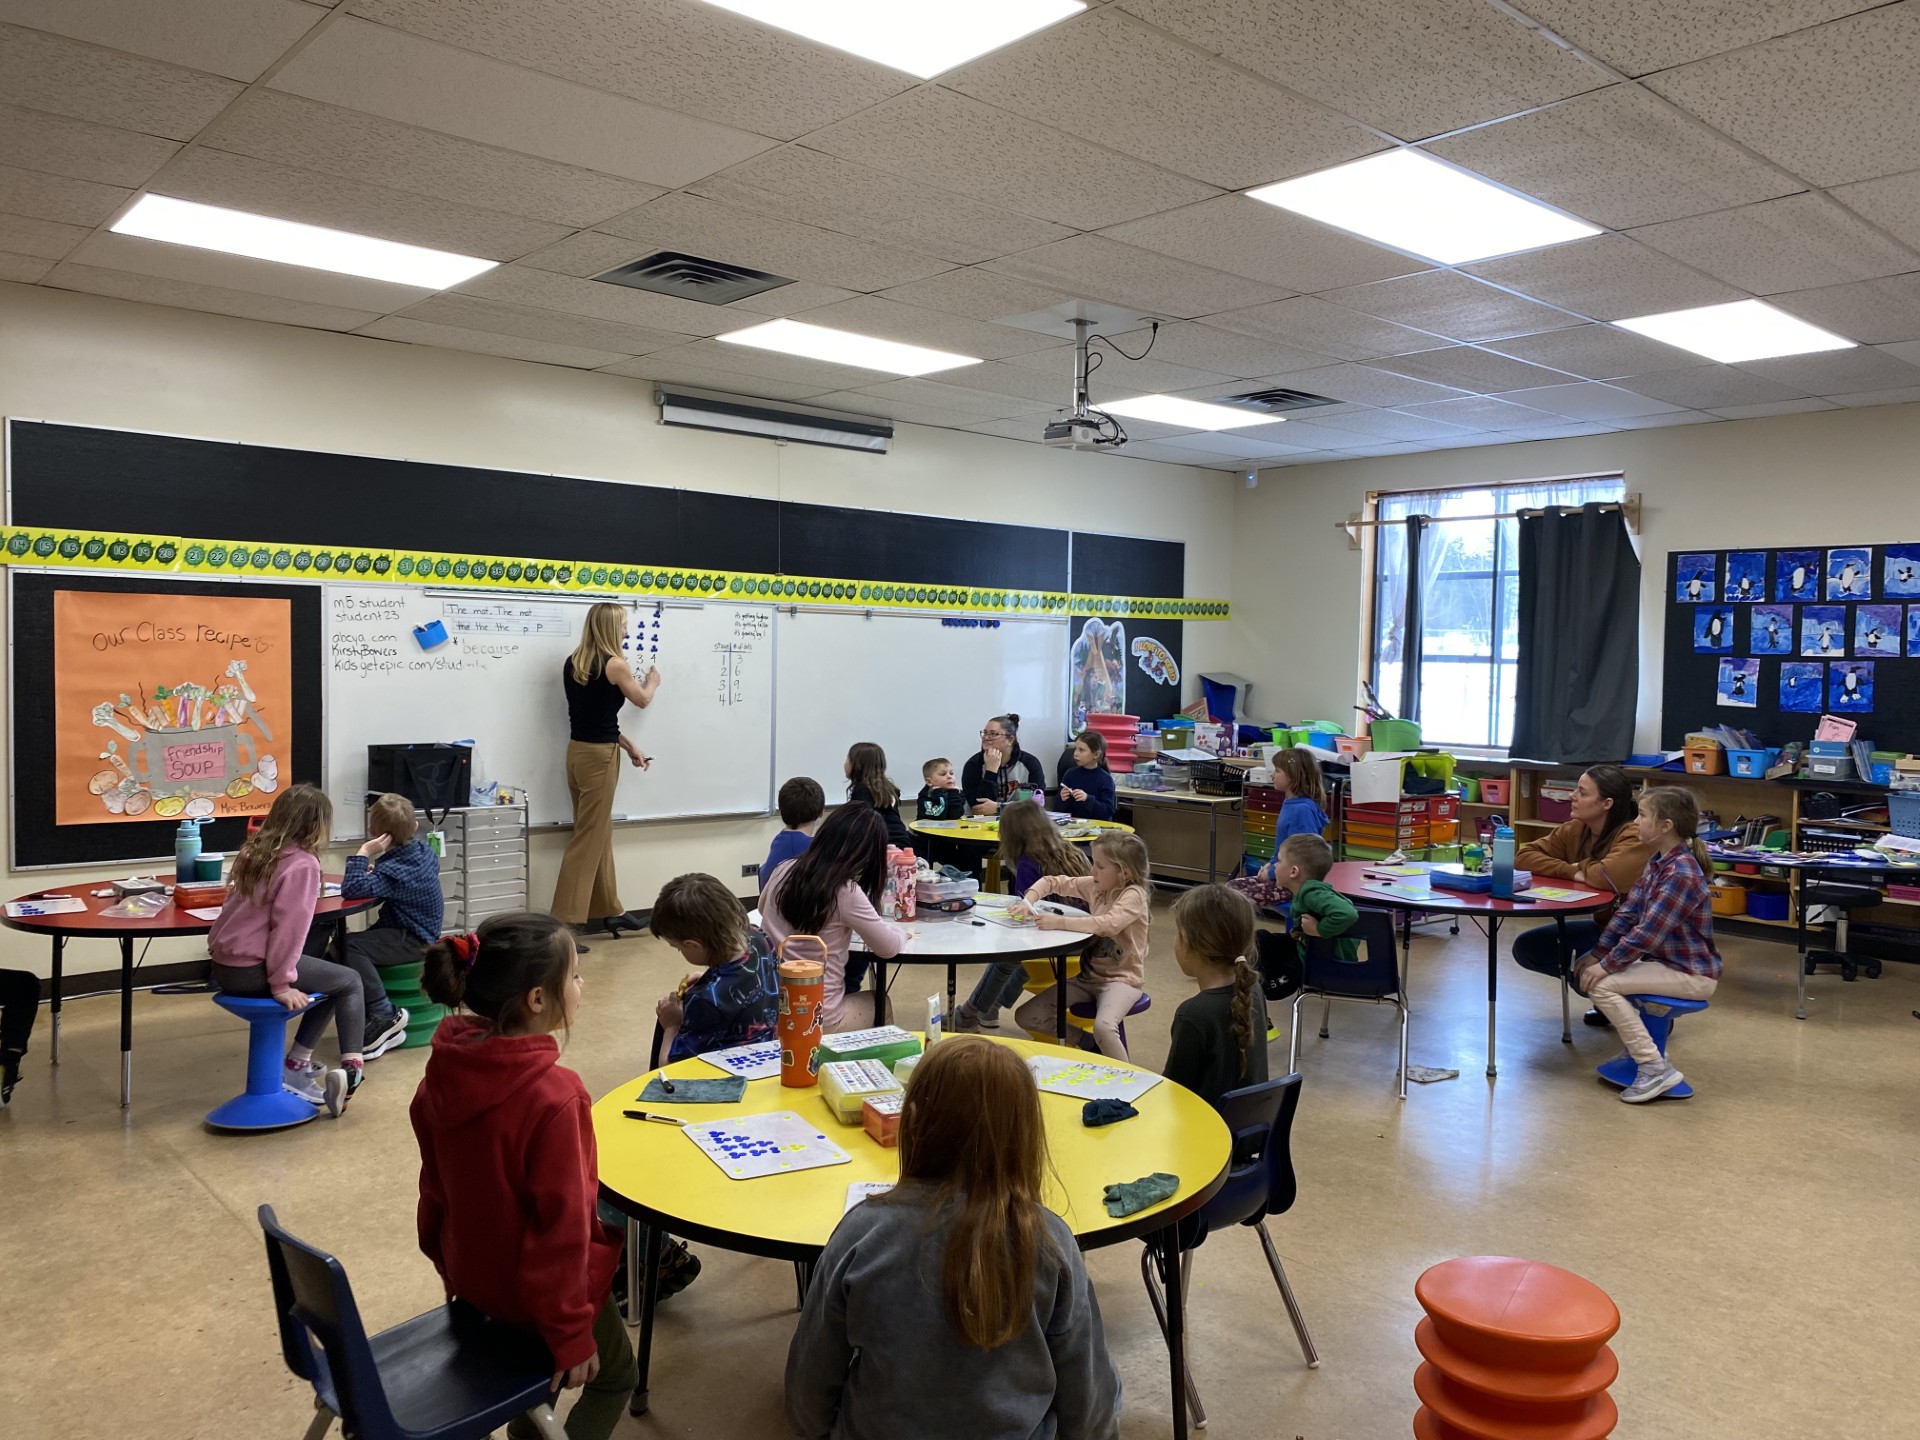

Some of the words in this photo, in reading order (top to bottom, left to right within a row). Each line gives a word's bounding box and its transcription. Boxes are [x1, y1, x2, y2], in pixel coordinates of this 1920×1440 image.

[13, 540, 25, 548] 14
[40, 540, 51, 550] 15
[65, 543, 76, 552] 16
[90, 544, 100, 554] 17
[114, 546, 126, 555] 18
[138, 547, 148, 556] 19
[158, 548, 173, 558] 20
[190, 552, 200, 560] 21
[211, 552, 223, 561] 22
[234, 554, 245, 562] 23
[255, 554, 267, 563] 24
[276, 555, 288, 564] 25
[297, 557, 308, 565] 26
[318, 558, 329, 566] 27
[338, 559, 349, 567] 28
[357, 560, 368, 568] 29
[376, 561, 388, 569] 30
[360, 596, 405, 608] student
[446, 604, 467, 614] The
[494, 606, 512, 616] The
[476, 622, 488, 631] the
[496, 623, 509, 632] the
[136, 622, 186, 642] Class
[196, 624, 251, 650] recipe
[332, 632, 365, 646] abcya
[463, 638, 519, 654] because
[636, 654, 644, 664] 3
[650, 654, 656, 664] 4
[722, 655, 725, 666] 1
[737, 654, 743, 664] 3
[721, 666, 728, 676] 2
[735, 665, 740, 676] 6
[718, 680, 726, 690] 3
[734, 680, 740, 690] 9
[719, 693, 726, 706] 4
[734, 692, 743, 702] 12
[240, 802, 271, 813] Bowers
